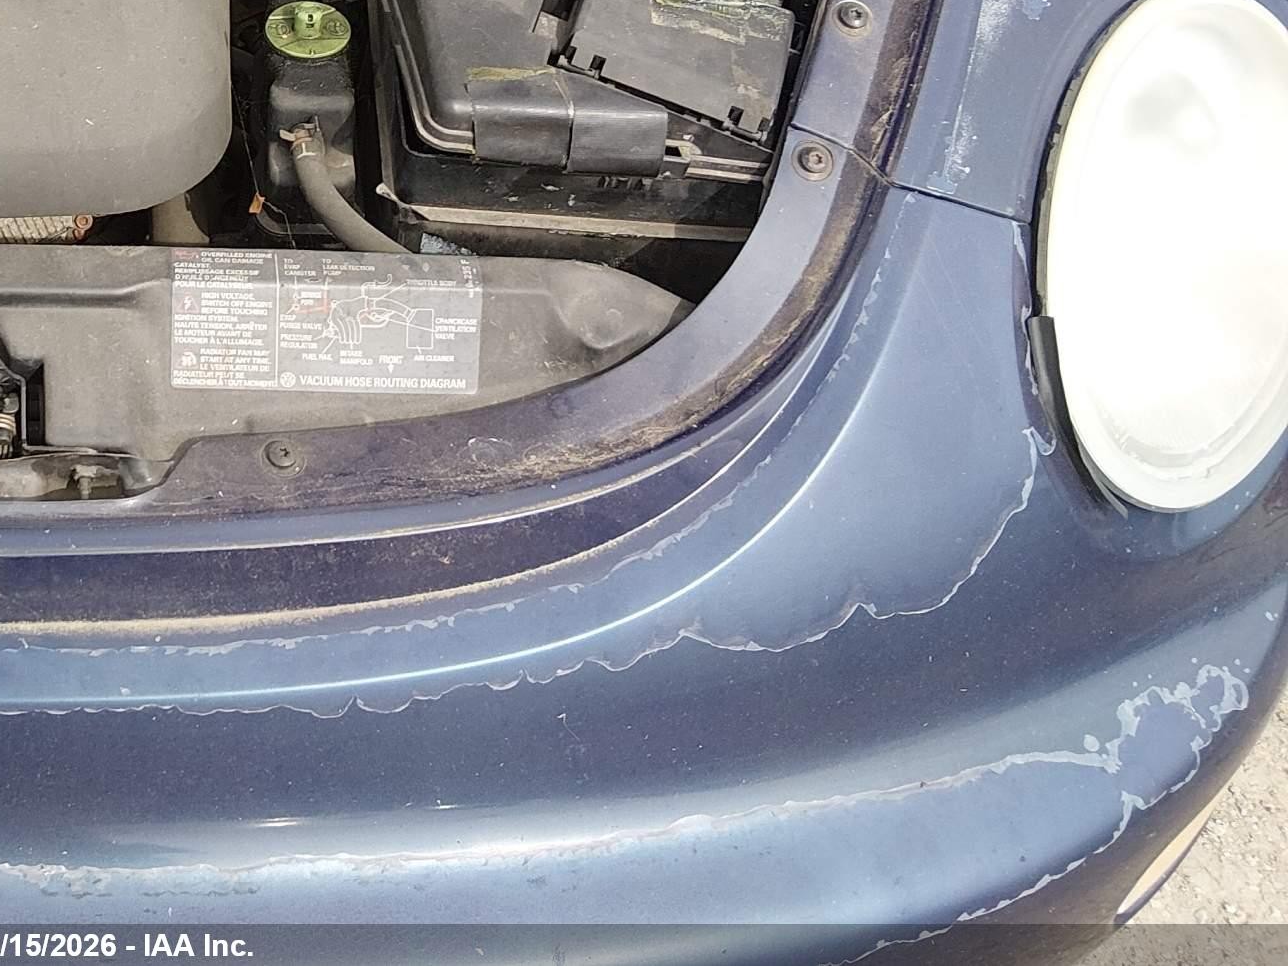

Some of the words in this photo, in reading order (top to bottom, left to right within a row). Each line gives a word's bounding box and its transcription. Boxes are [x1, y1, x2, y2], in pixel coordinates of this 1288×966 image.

[201, 299, 230, 307] SWITCH
[230, 307, 268, 315] TOUCHING
[435, 317, 478, 325] CRANKCASE
[183, 329, 215, 337] MOTEUR
[435, 325, 477, 333] VENTILATION
[174, 336, 209, 344] TOUCHER
[200, 355, 223, 363] START
[339, 357, 374, 365] MANIFOLD
[209, 364, 258, 372] VENTILATEUR
[173, 370, 214, 378] RADIATEUR
[214, 371, 234, 379] PEUT
[299, 375, 343, 386] VACUUM
[344, 375, 372, 387] HOSE
[373, 377, 419, 388] ROUTING
[419, 378, 467, 389] DIAGRAM
